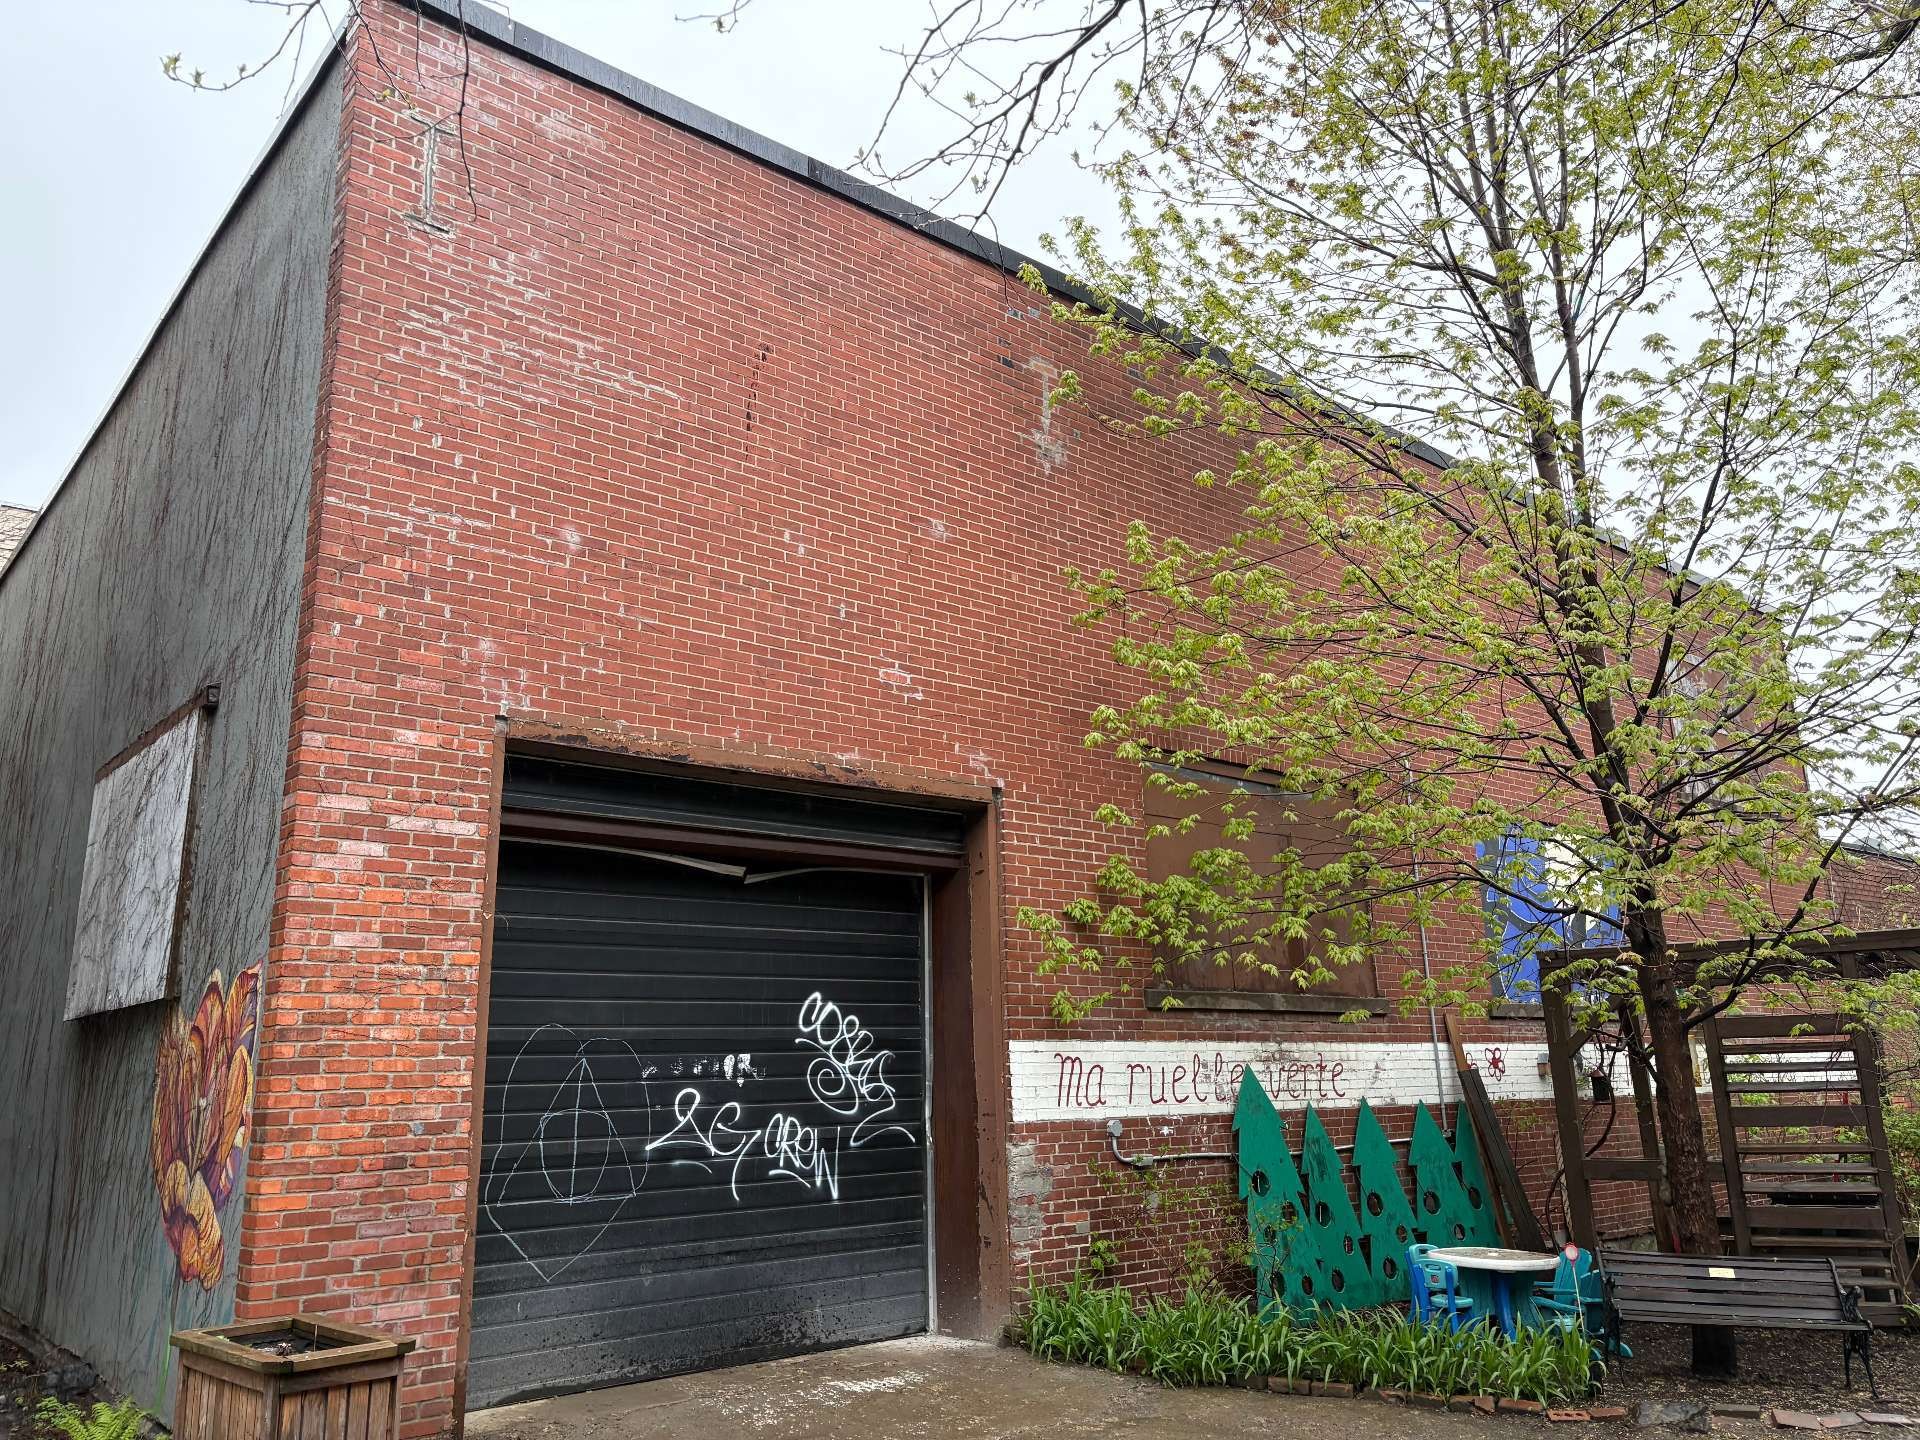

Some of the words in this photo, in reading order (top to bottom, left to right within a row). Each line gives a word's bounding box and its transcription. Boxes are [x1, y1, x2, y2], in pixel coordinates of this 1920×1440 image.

[1053, 1052, 1107, 1107] Ma
[1126, 1052, 1244, 1105] ruelle
[1269, 1052, 1346, 1100] verte
